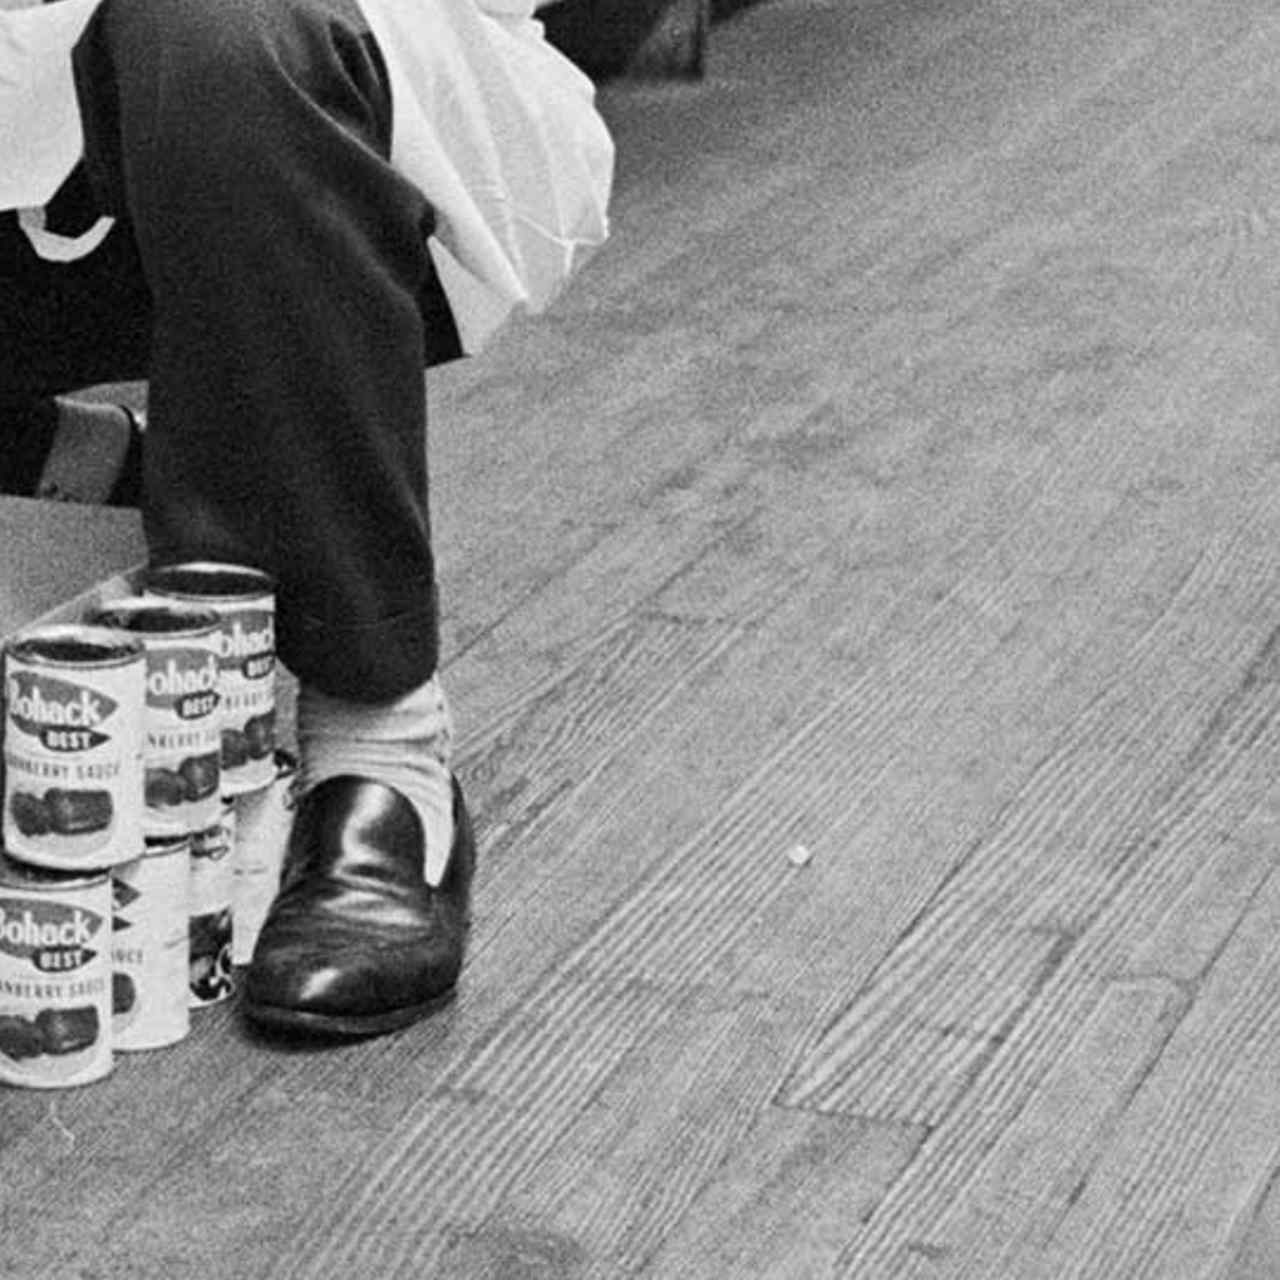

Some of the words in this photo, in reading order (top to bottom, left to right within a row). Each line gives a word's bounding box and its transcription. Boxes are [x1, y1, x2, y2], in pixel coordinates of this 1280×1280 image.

[181, 692, 217, 717] BEST
[45, 727, 92, 750] BEST
[40, 948, 88, 971] BEST
